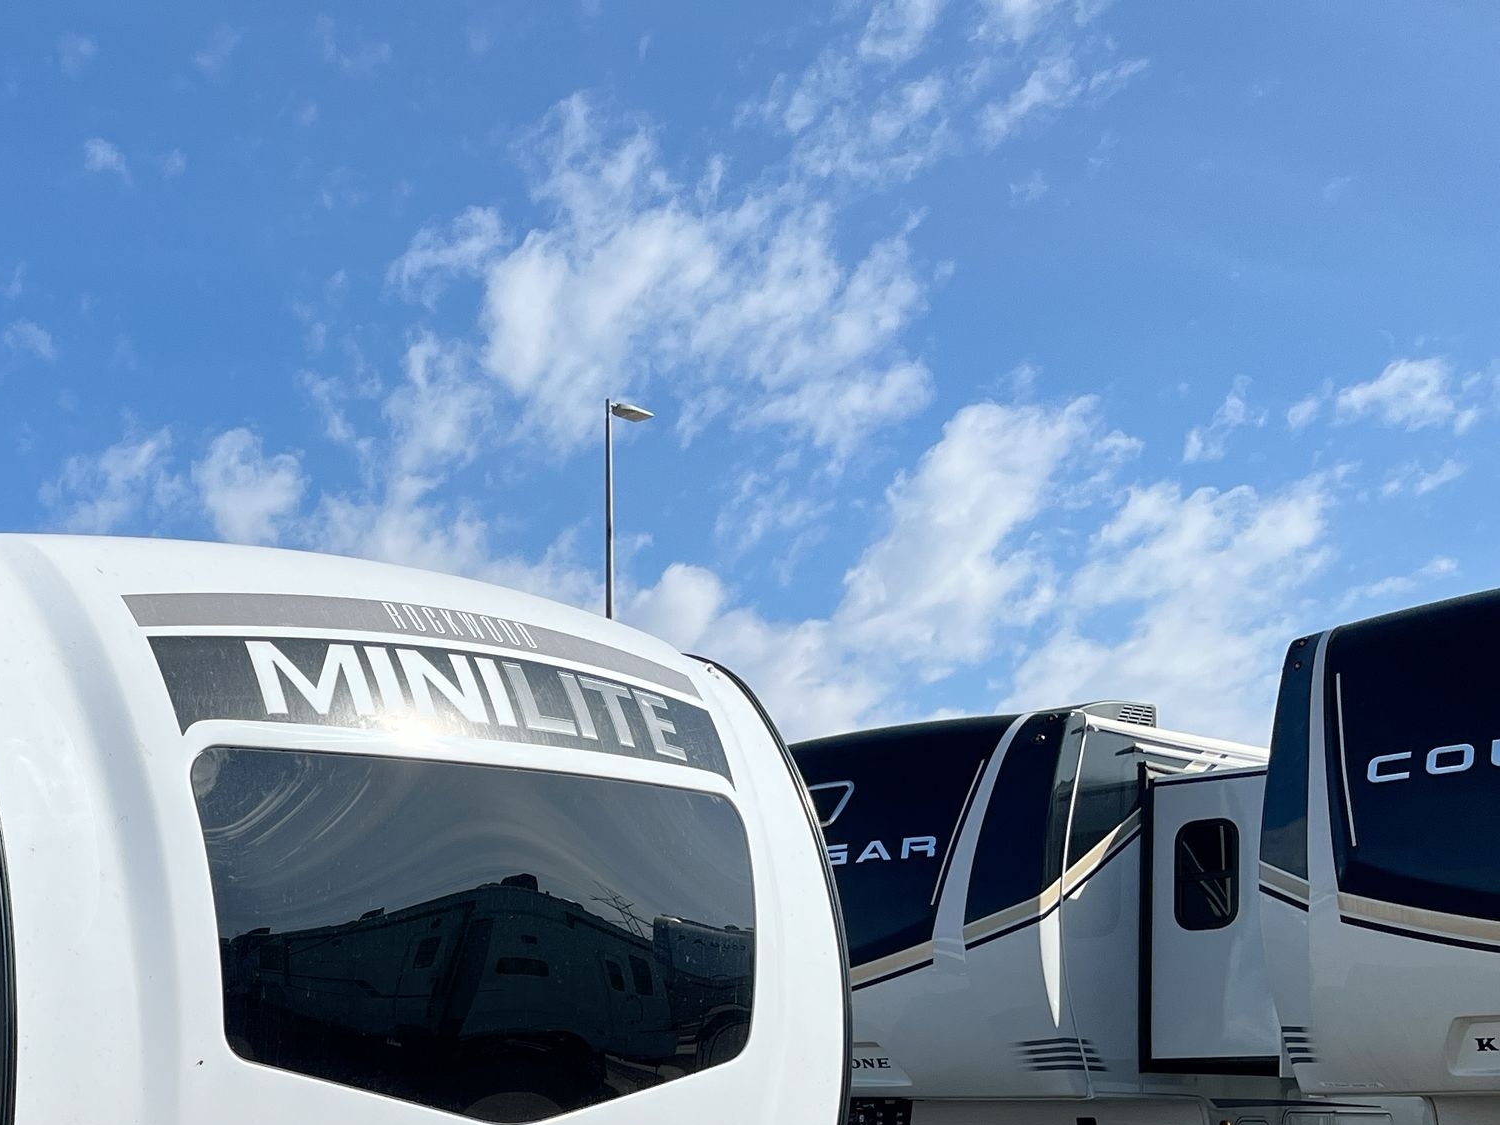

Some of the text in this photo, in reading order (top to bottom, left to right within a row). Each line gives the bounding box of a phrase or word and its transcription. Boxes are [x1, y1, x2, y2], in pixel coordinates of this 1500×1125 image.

[381, 601, 539, 649] ROCKWOOD
[244, 640, 687, 762] MINILITE
[1366, 738, 1500, 784] CO
